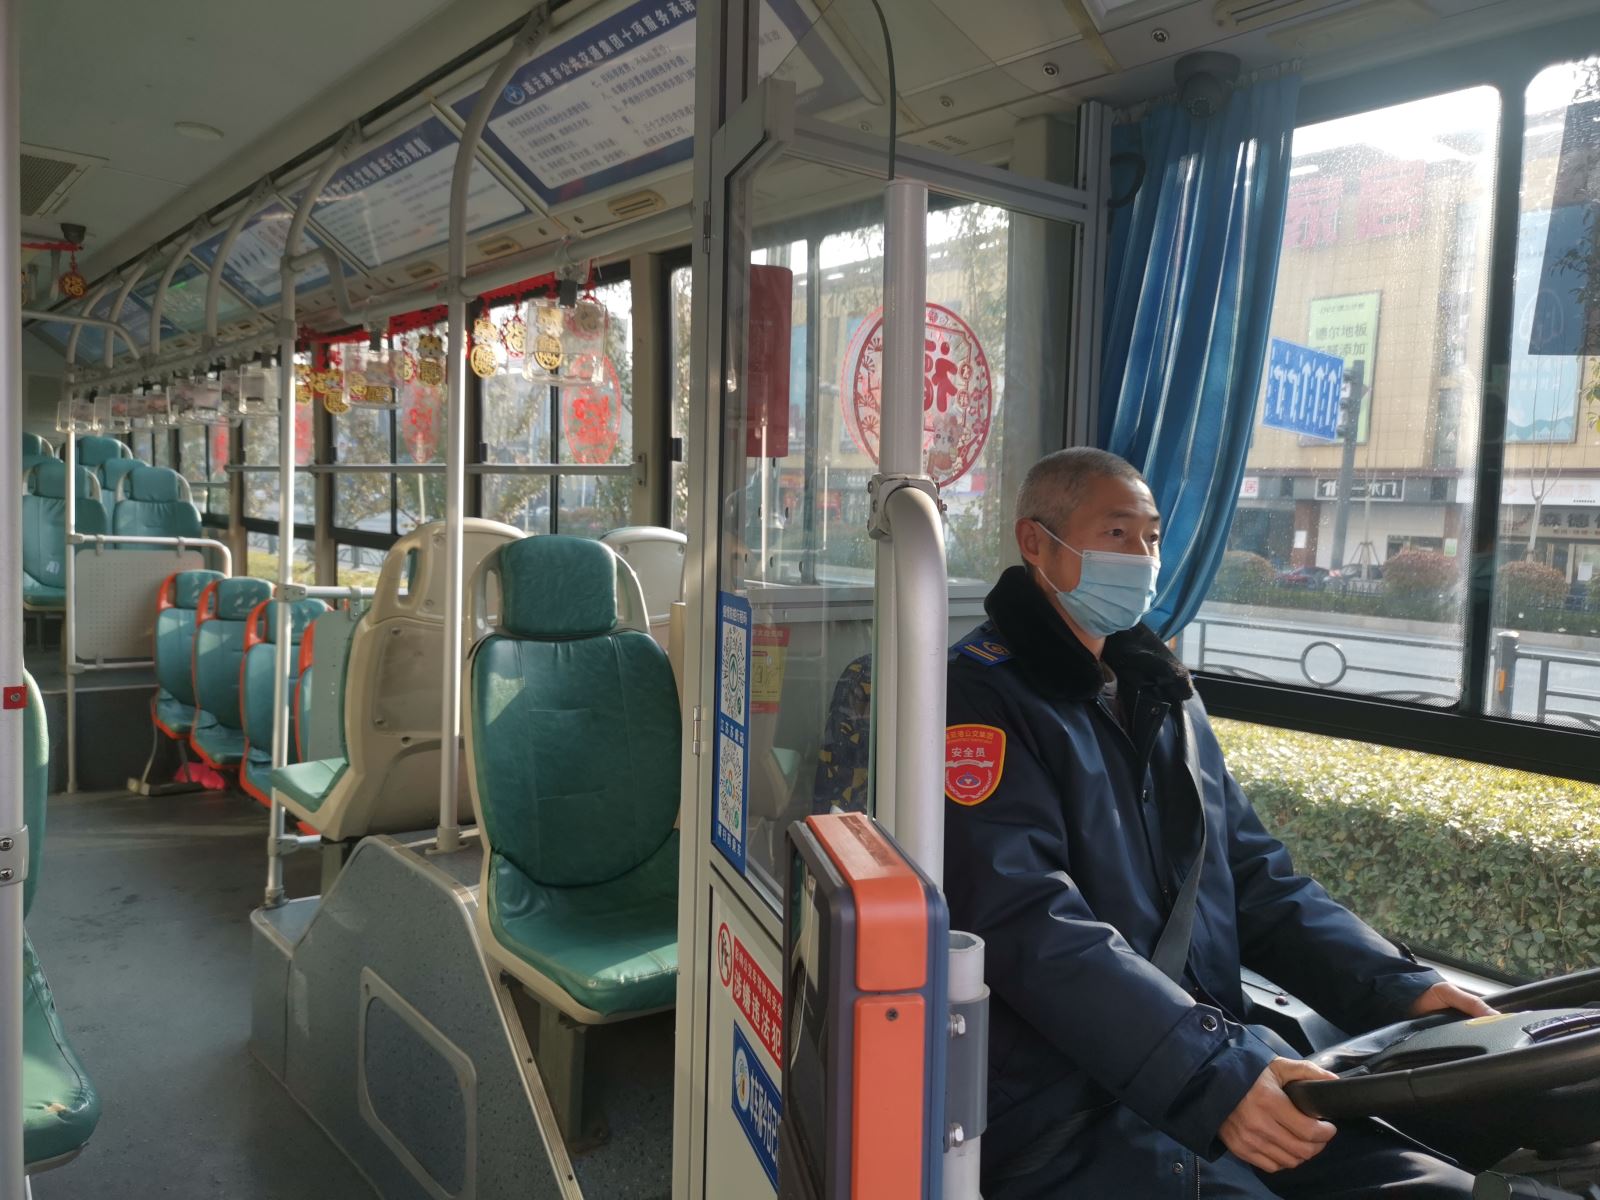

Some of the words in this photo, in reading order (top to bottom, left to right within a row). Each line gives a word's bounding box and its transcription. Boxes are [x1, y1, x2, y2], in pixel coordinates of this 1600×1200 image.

[951, 746, 985, 758] 安全员
[734, 967, 781, 1060] 涉嫌违法犯
